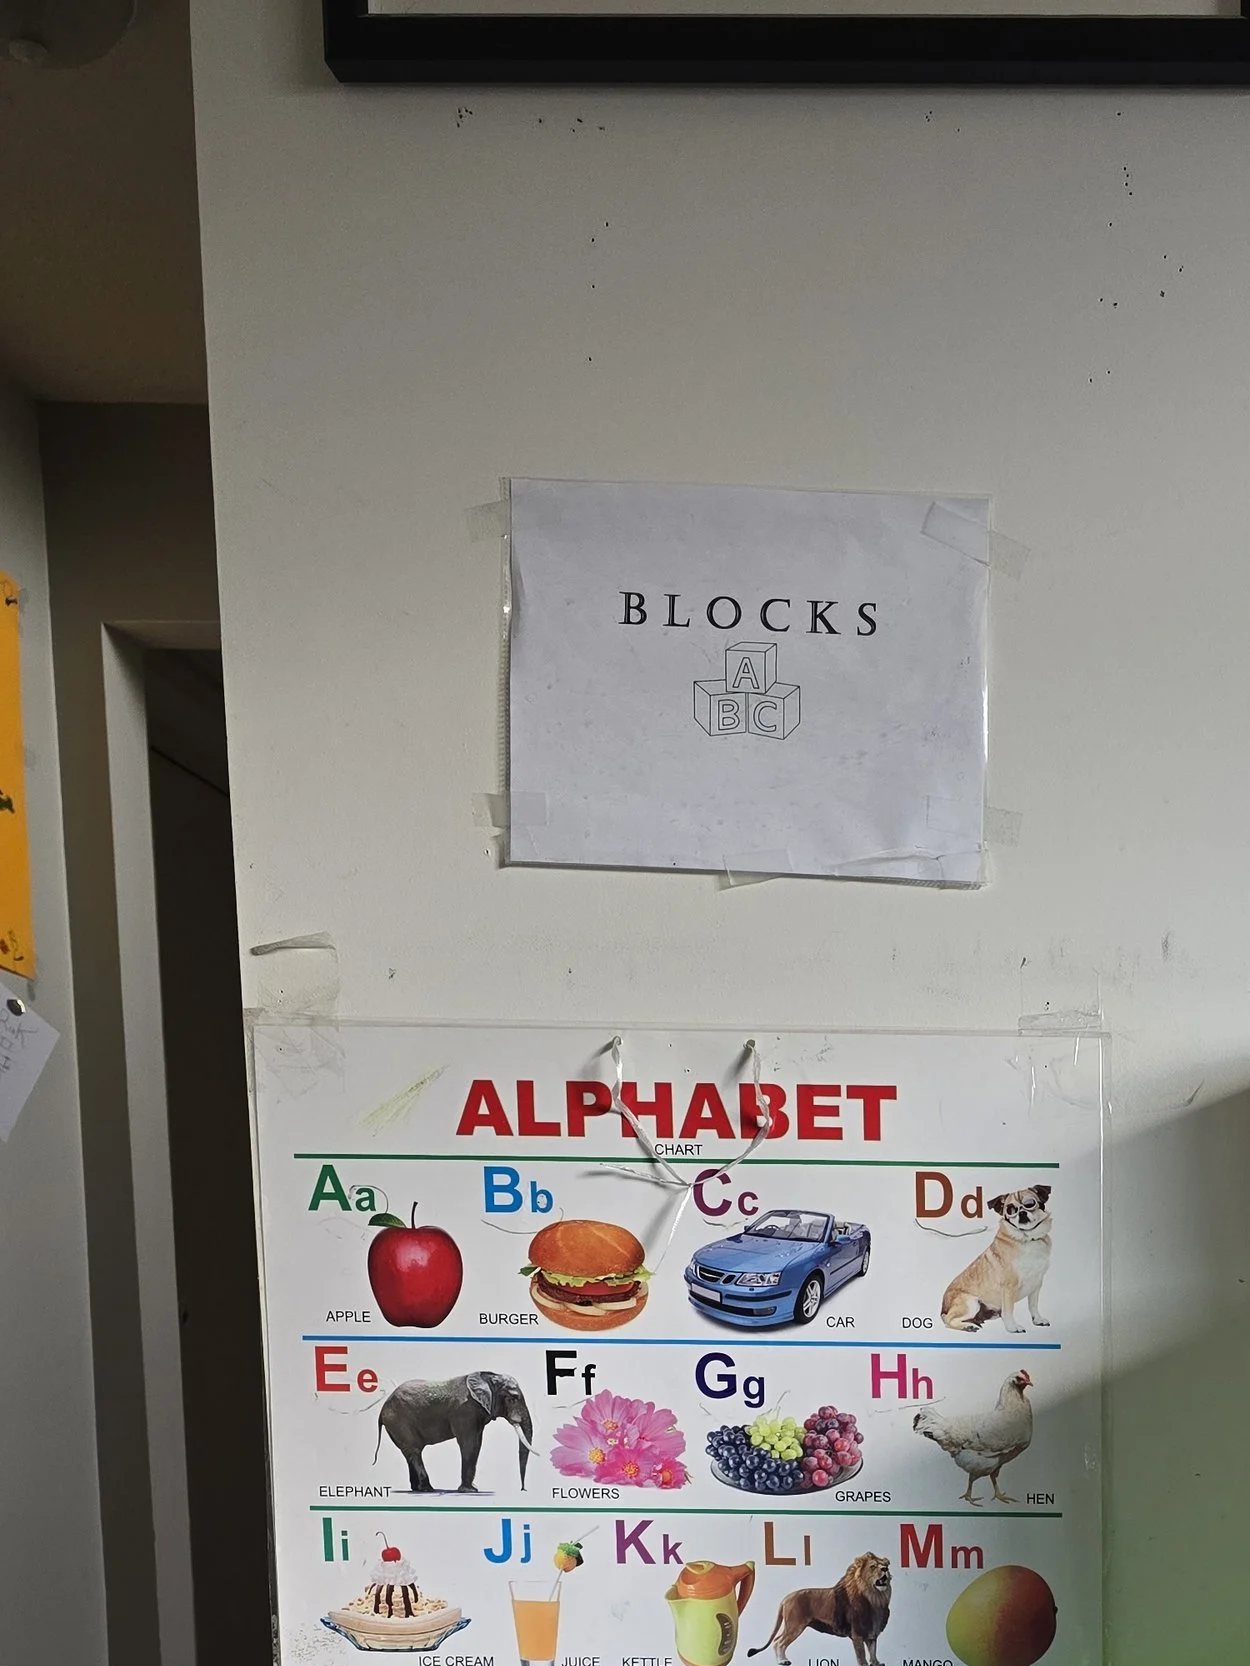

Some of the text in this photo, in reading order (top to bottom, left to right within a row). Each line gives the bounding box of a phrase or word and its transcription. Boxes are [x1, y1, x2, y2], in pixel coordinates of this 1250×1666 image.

[619, 592, 876, 636] BLOCKS
[732, 656, 760, 689] A
[456, 1080, 898, 1141] ALPHABET
[654, 1143, 703, 1156] CHART
[325, 1310, 372, 1323] APPLE
[479, 1312, 540, 1326] BURGER
[826, 1315, 856, 1328] CAR
[902, 1316, 933, 1329] DOG
[319, 1485, 391, 1498] ELEPHANT
[552, 1487, 620, 1500] FLOWERS
[835, 1490, 892, 1503] GRAPES
[1026, 1493, 1055, 1505] HEN
